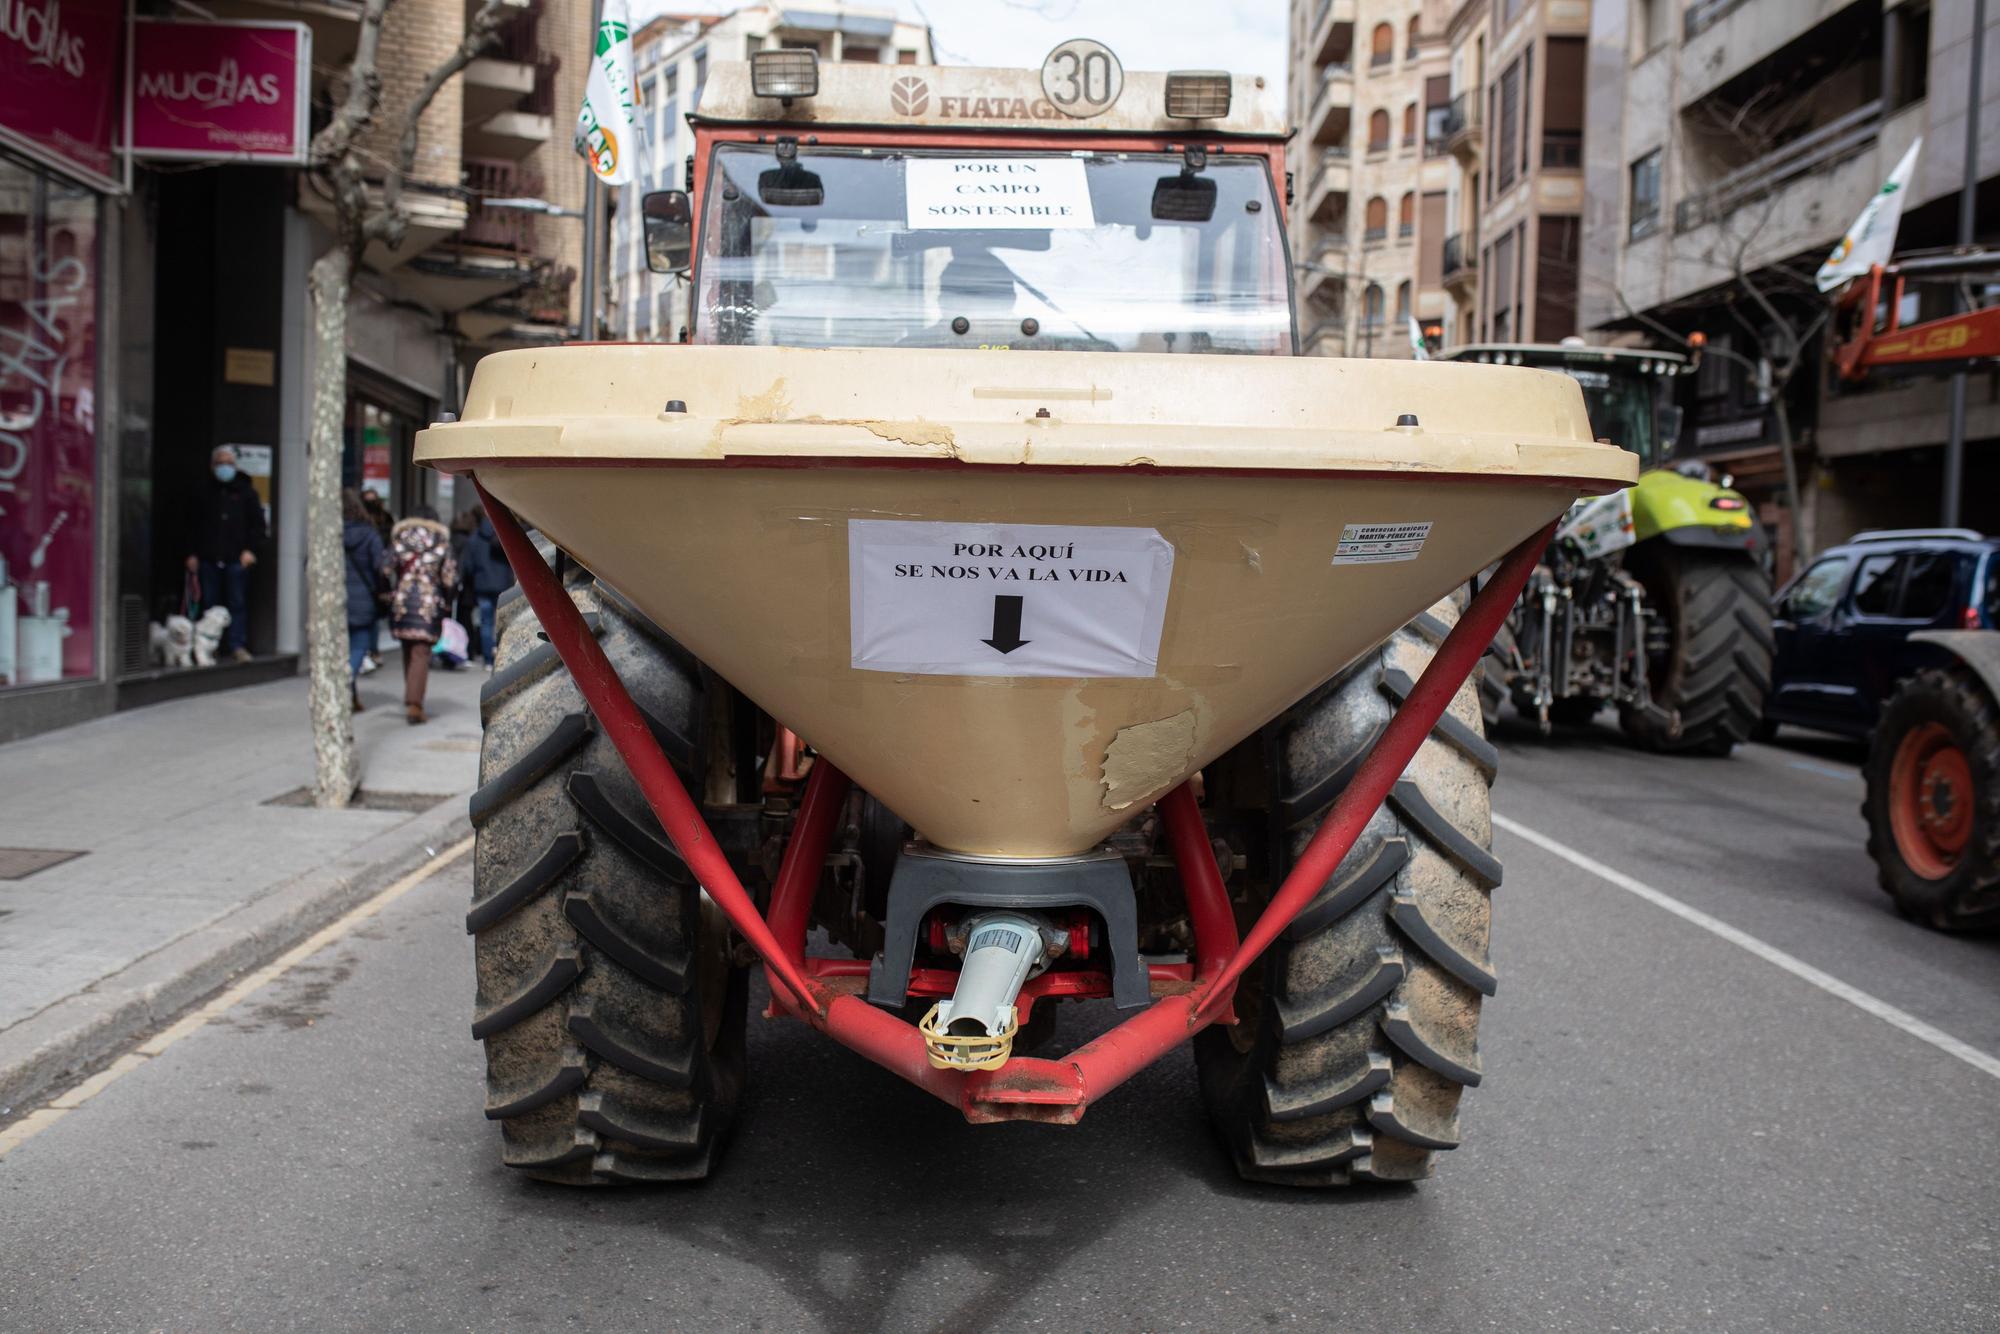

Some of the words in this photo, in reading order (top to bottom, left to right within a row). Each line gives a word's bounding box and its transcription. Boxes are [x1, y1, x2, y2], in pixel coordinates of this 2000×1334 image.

[0, 0, 84, 78] UCHAS
[138, 57, 280, 109] MUCHAS
[1053, 50, 1112, 106] 30
[939, 96, 1086, 120] FIATAG
[954, 164, 1000, 173] POR
[1007, 164, 1037, 173] UN
[956, 184, 1041, 194] CAMPO
[928, 205, 1073, 216] SOSTENIBLE
[0, 256, 87, 515] UCHAS
[954, 543, 1004, 558] POR
[1011, 542, 1075, 562] AQUÍ
[894, 564, 923, 578] SE
[930, 565, 980, 580] NOS
[988, 567, 1021, 581] VA
[1029, 568, 1060, 582] LA
[1068, 568, 1128, 583] VIDA
